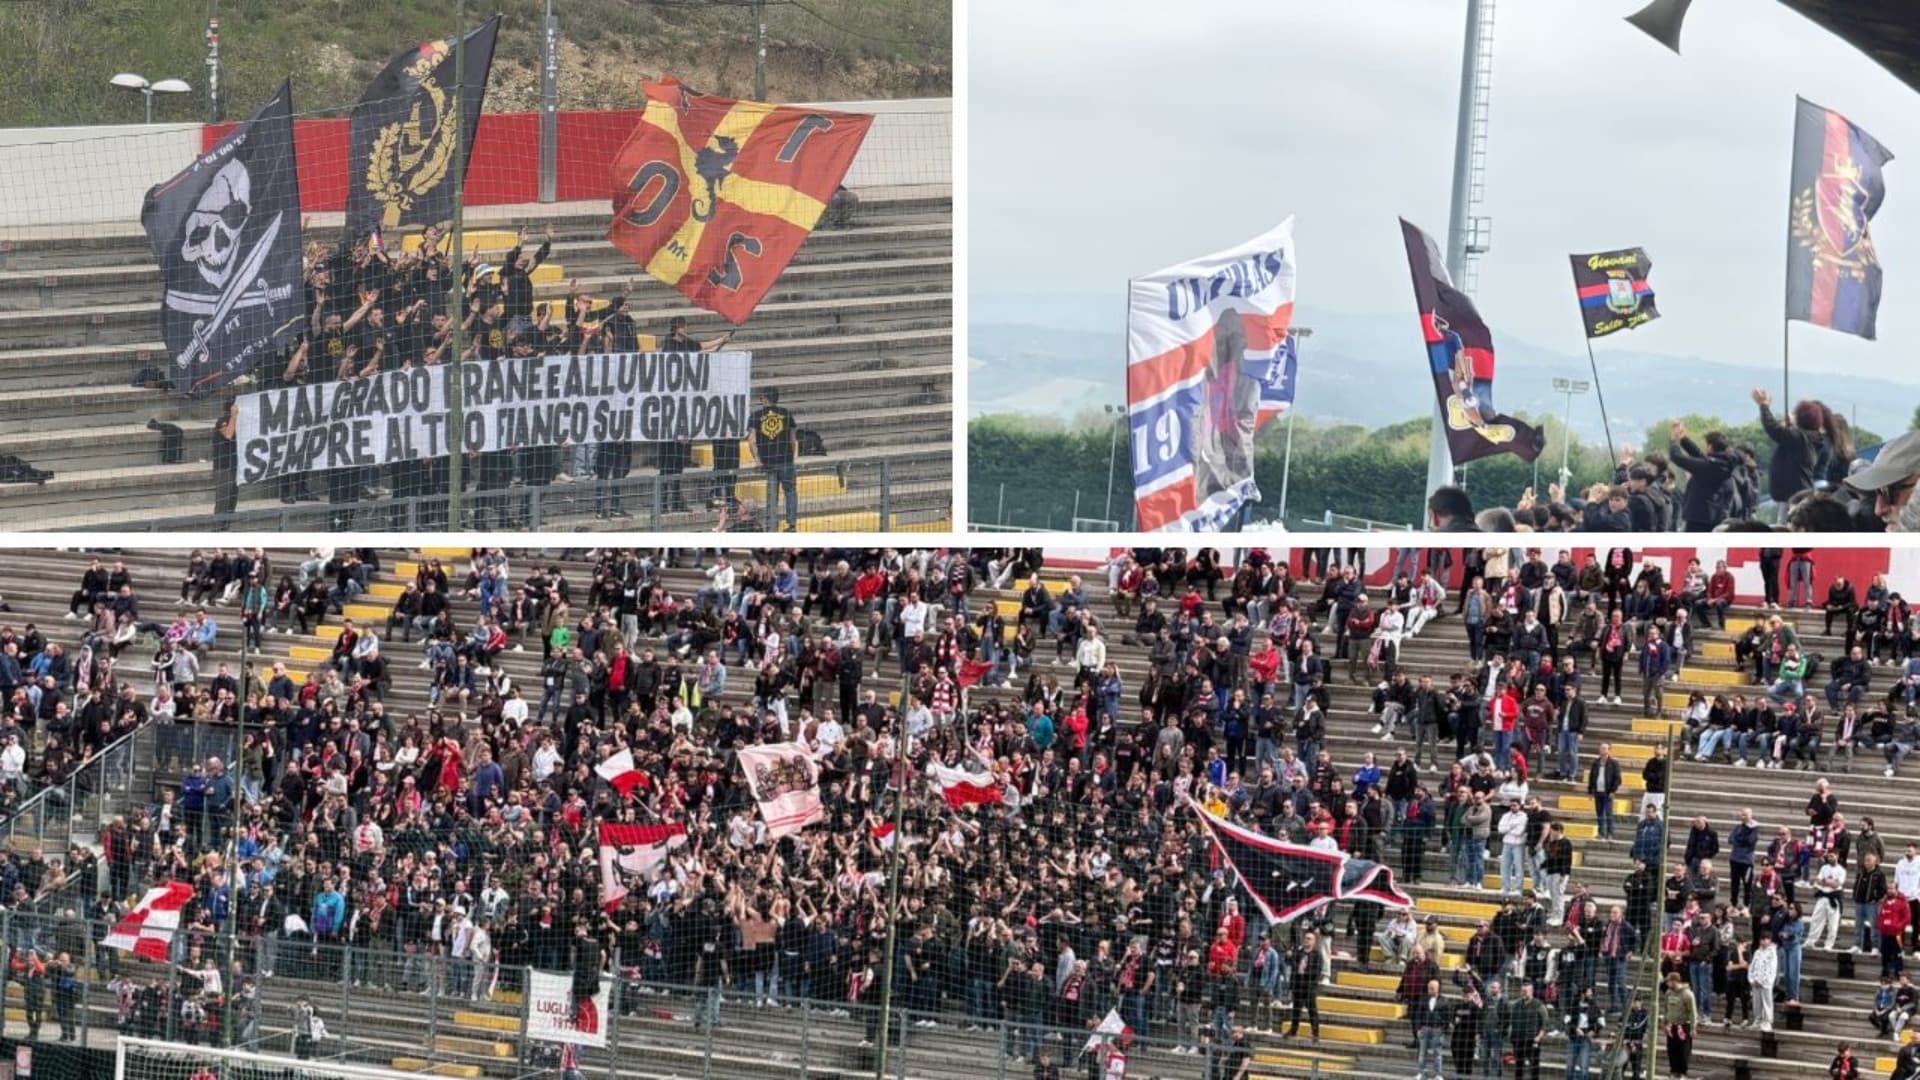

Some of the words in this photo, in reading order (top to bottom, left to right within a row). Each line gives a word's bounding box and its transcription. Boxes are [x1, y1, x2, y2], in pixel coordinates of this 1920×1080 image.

[259, 366, 431, 435] MALGRADO
[563, 353, 711, 397] ALLUVIONI
[243, 419, 376, 482] SEMPRE
[385, 415, 418, 463] AL
[496, 401, 589, 448] FIANCO
[640, 394, 747, 440] GRADONI
[1133, 408, 1182, 476] 19
